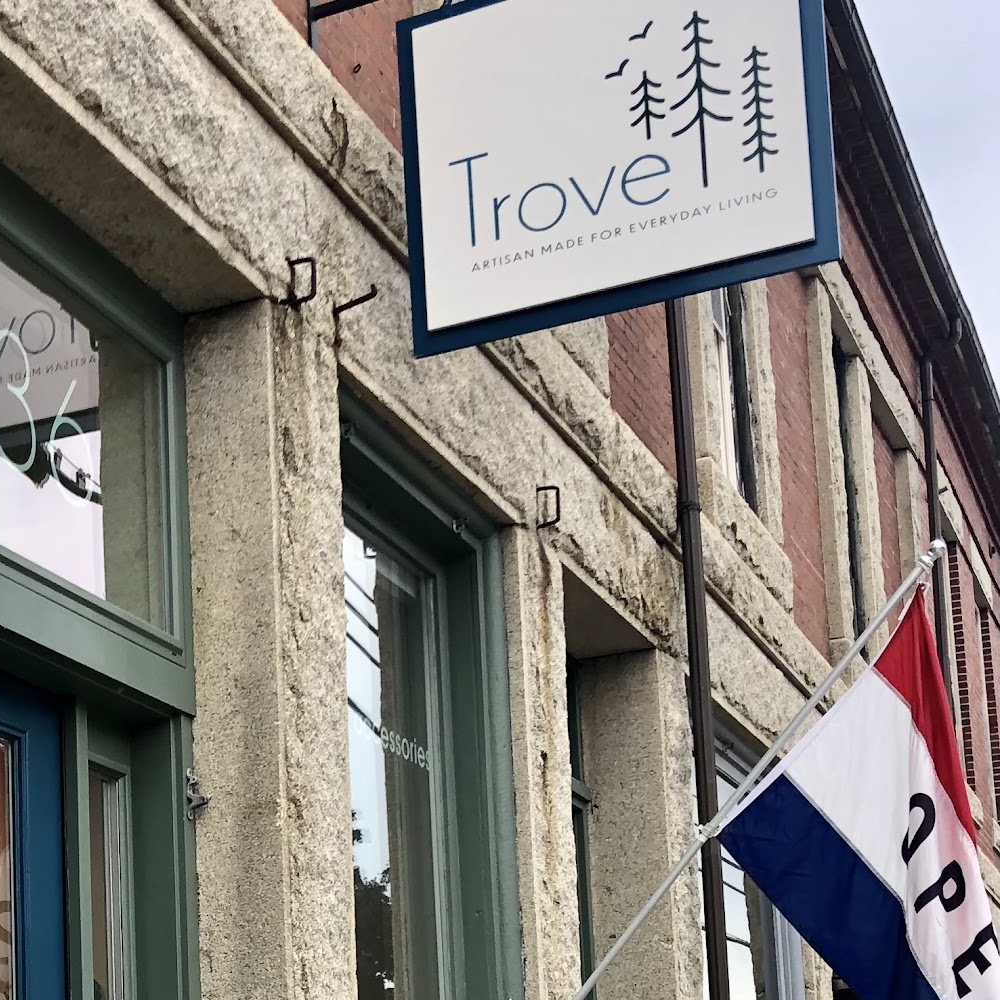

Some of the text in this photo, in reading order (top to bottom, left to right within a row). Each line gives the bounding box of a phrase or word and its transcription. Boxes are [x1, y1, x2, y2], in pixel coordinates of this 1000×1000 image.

[448, 152, 671, 248] Trove
[470, 187, 779, 273] ARTISAN MADE FOR EVERYDAY LIVING
